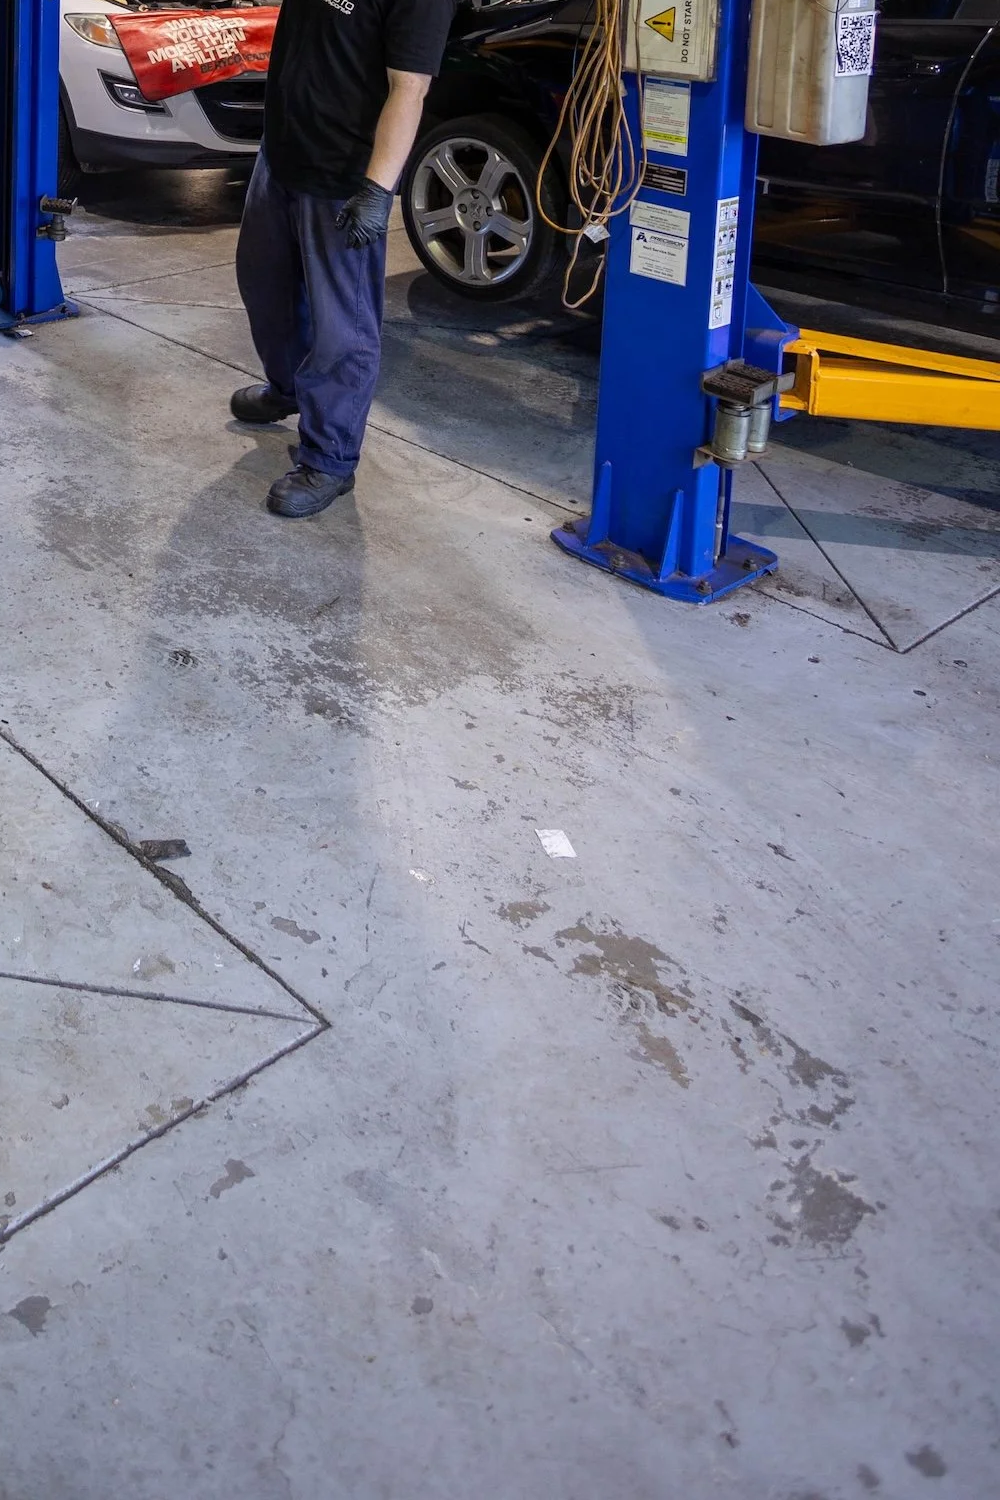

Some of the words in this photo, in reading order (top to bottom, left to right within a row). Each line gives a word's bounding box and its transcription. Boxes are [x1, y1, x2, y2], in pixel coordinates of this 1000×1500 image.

[168, 24, 203, 44] YOU
[201, 16, 247, 34] NEED
[682, 28, 691, 47] NOT
[147, 41, 199, 64] MORE
[199, 27, 246, 50] THAN
[172, 60, 186, 73] A
[184, 44, 239, 68] FILTER
[681, 48, 689, 63] DO
